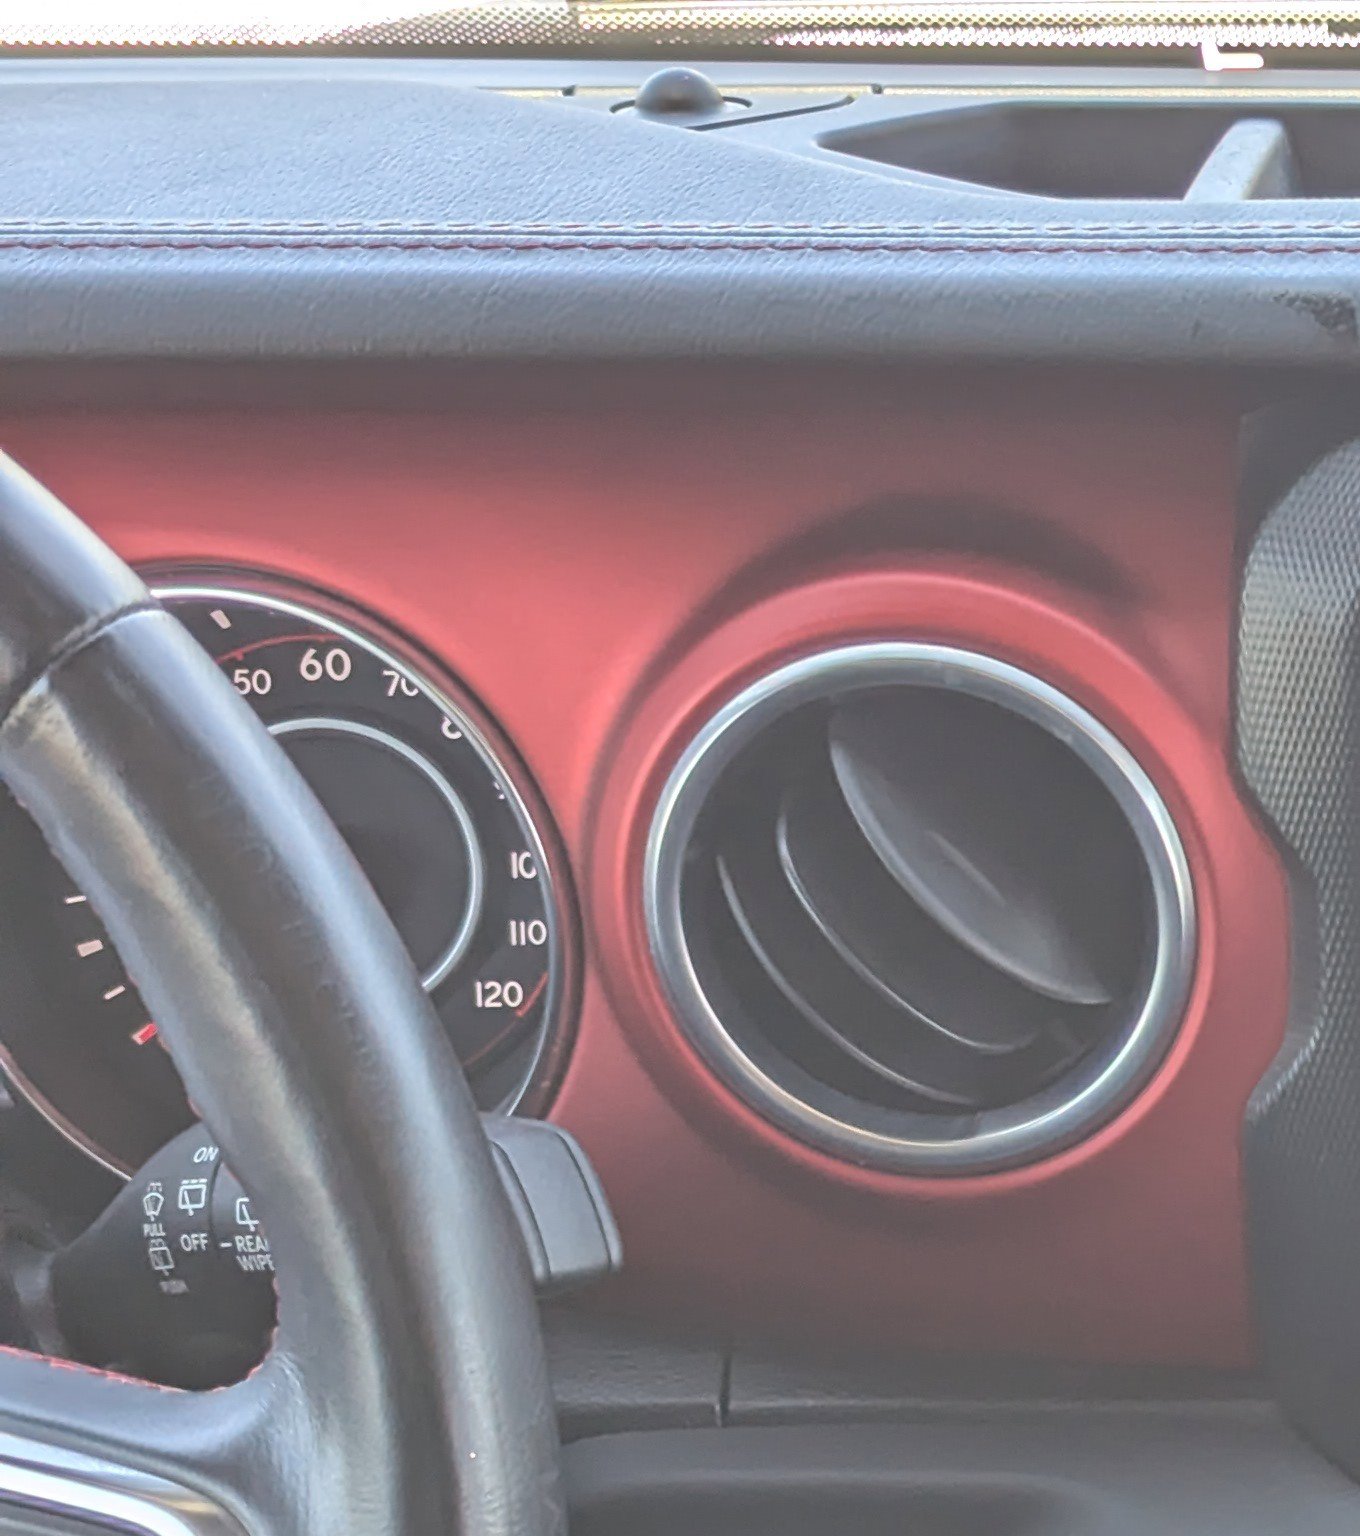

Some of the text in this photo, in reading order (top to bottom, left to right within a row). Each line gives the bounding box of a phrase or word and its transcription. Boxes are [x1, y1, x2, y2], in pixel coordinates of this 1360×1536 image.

[300, 648, 352, 681] 60
[233, 669, 271, 695] 50
[509, 920, 547, 946] 110
[475, 981, 523, 1007] 120
[193, 1146, 219, 1163] ON
[180, 1233, 208, 1251] OFF
[235, 1235, 269, 1252] REA
